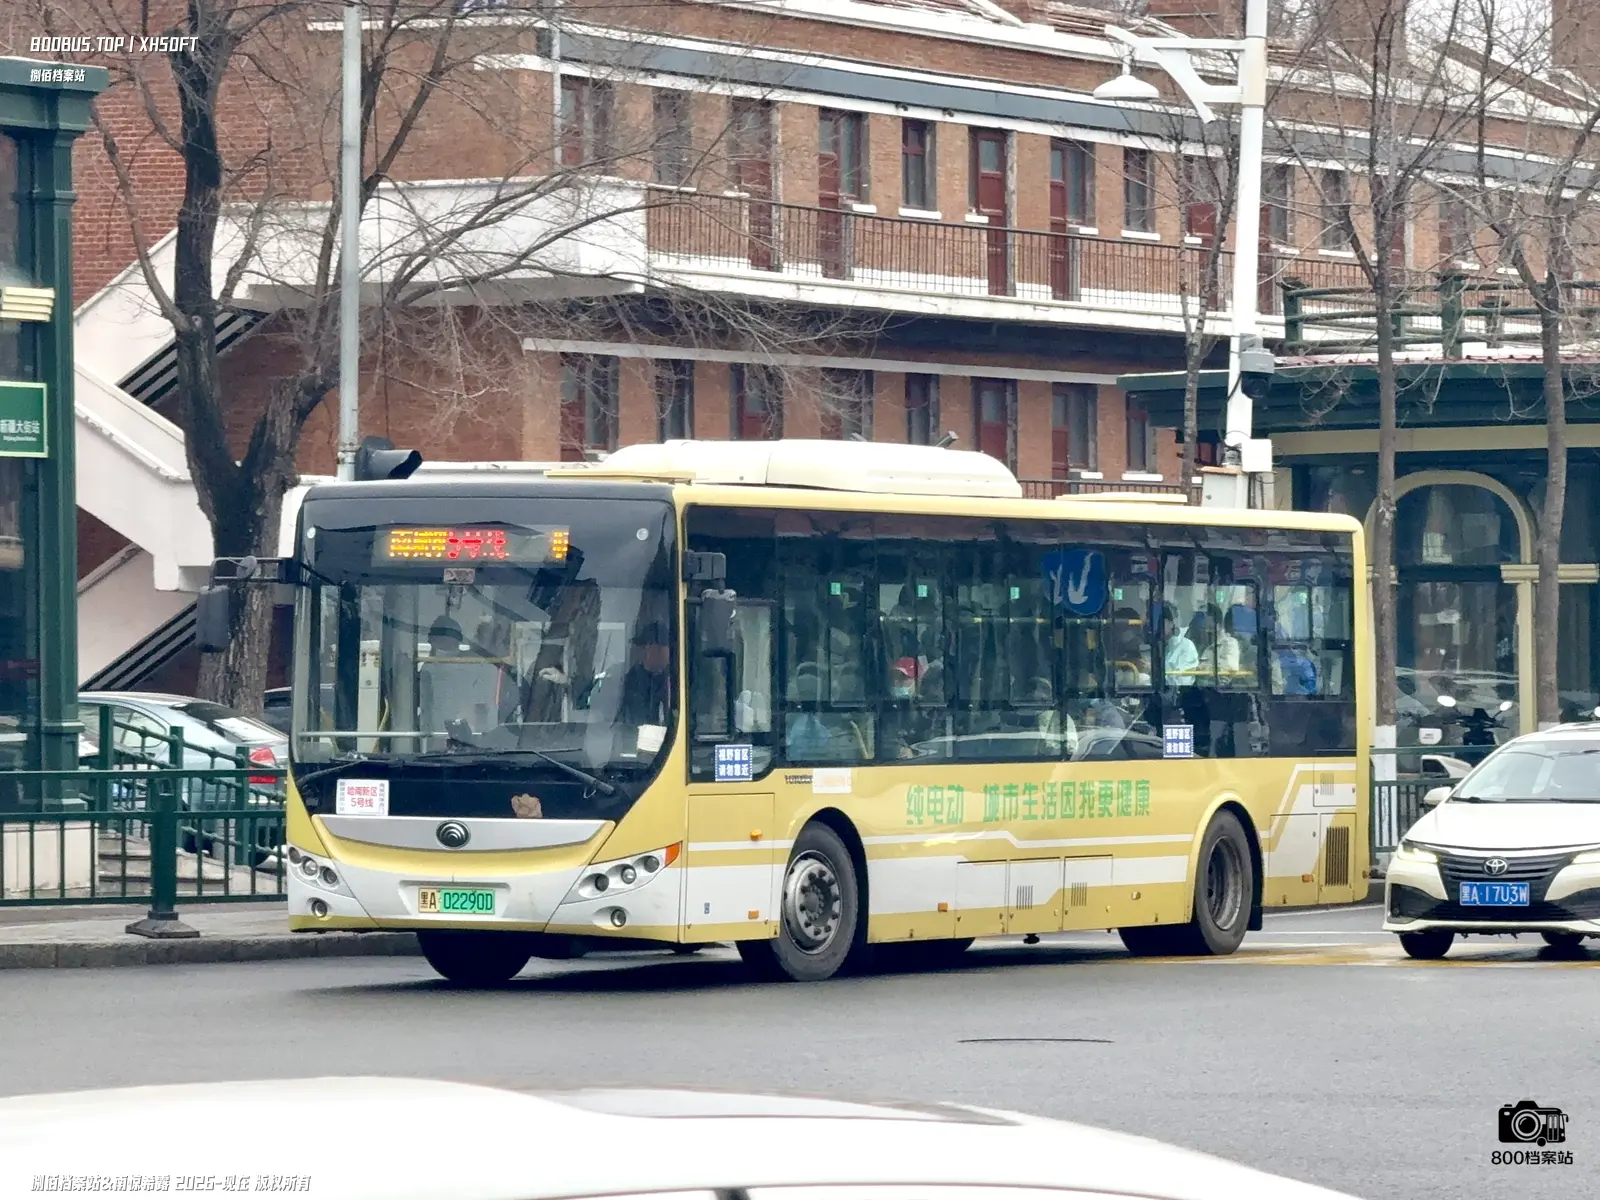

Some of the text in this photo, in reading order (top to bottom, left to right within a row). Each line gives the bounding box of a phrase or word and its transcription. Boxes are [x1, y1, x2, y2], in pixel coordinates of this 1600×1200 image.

[347, 786, 378, 797] 哈南新区
[350, 798, 374, 808] 5号线
[906, 779, 1150, 825] 纯电动 城市生活因我更健康
